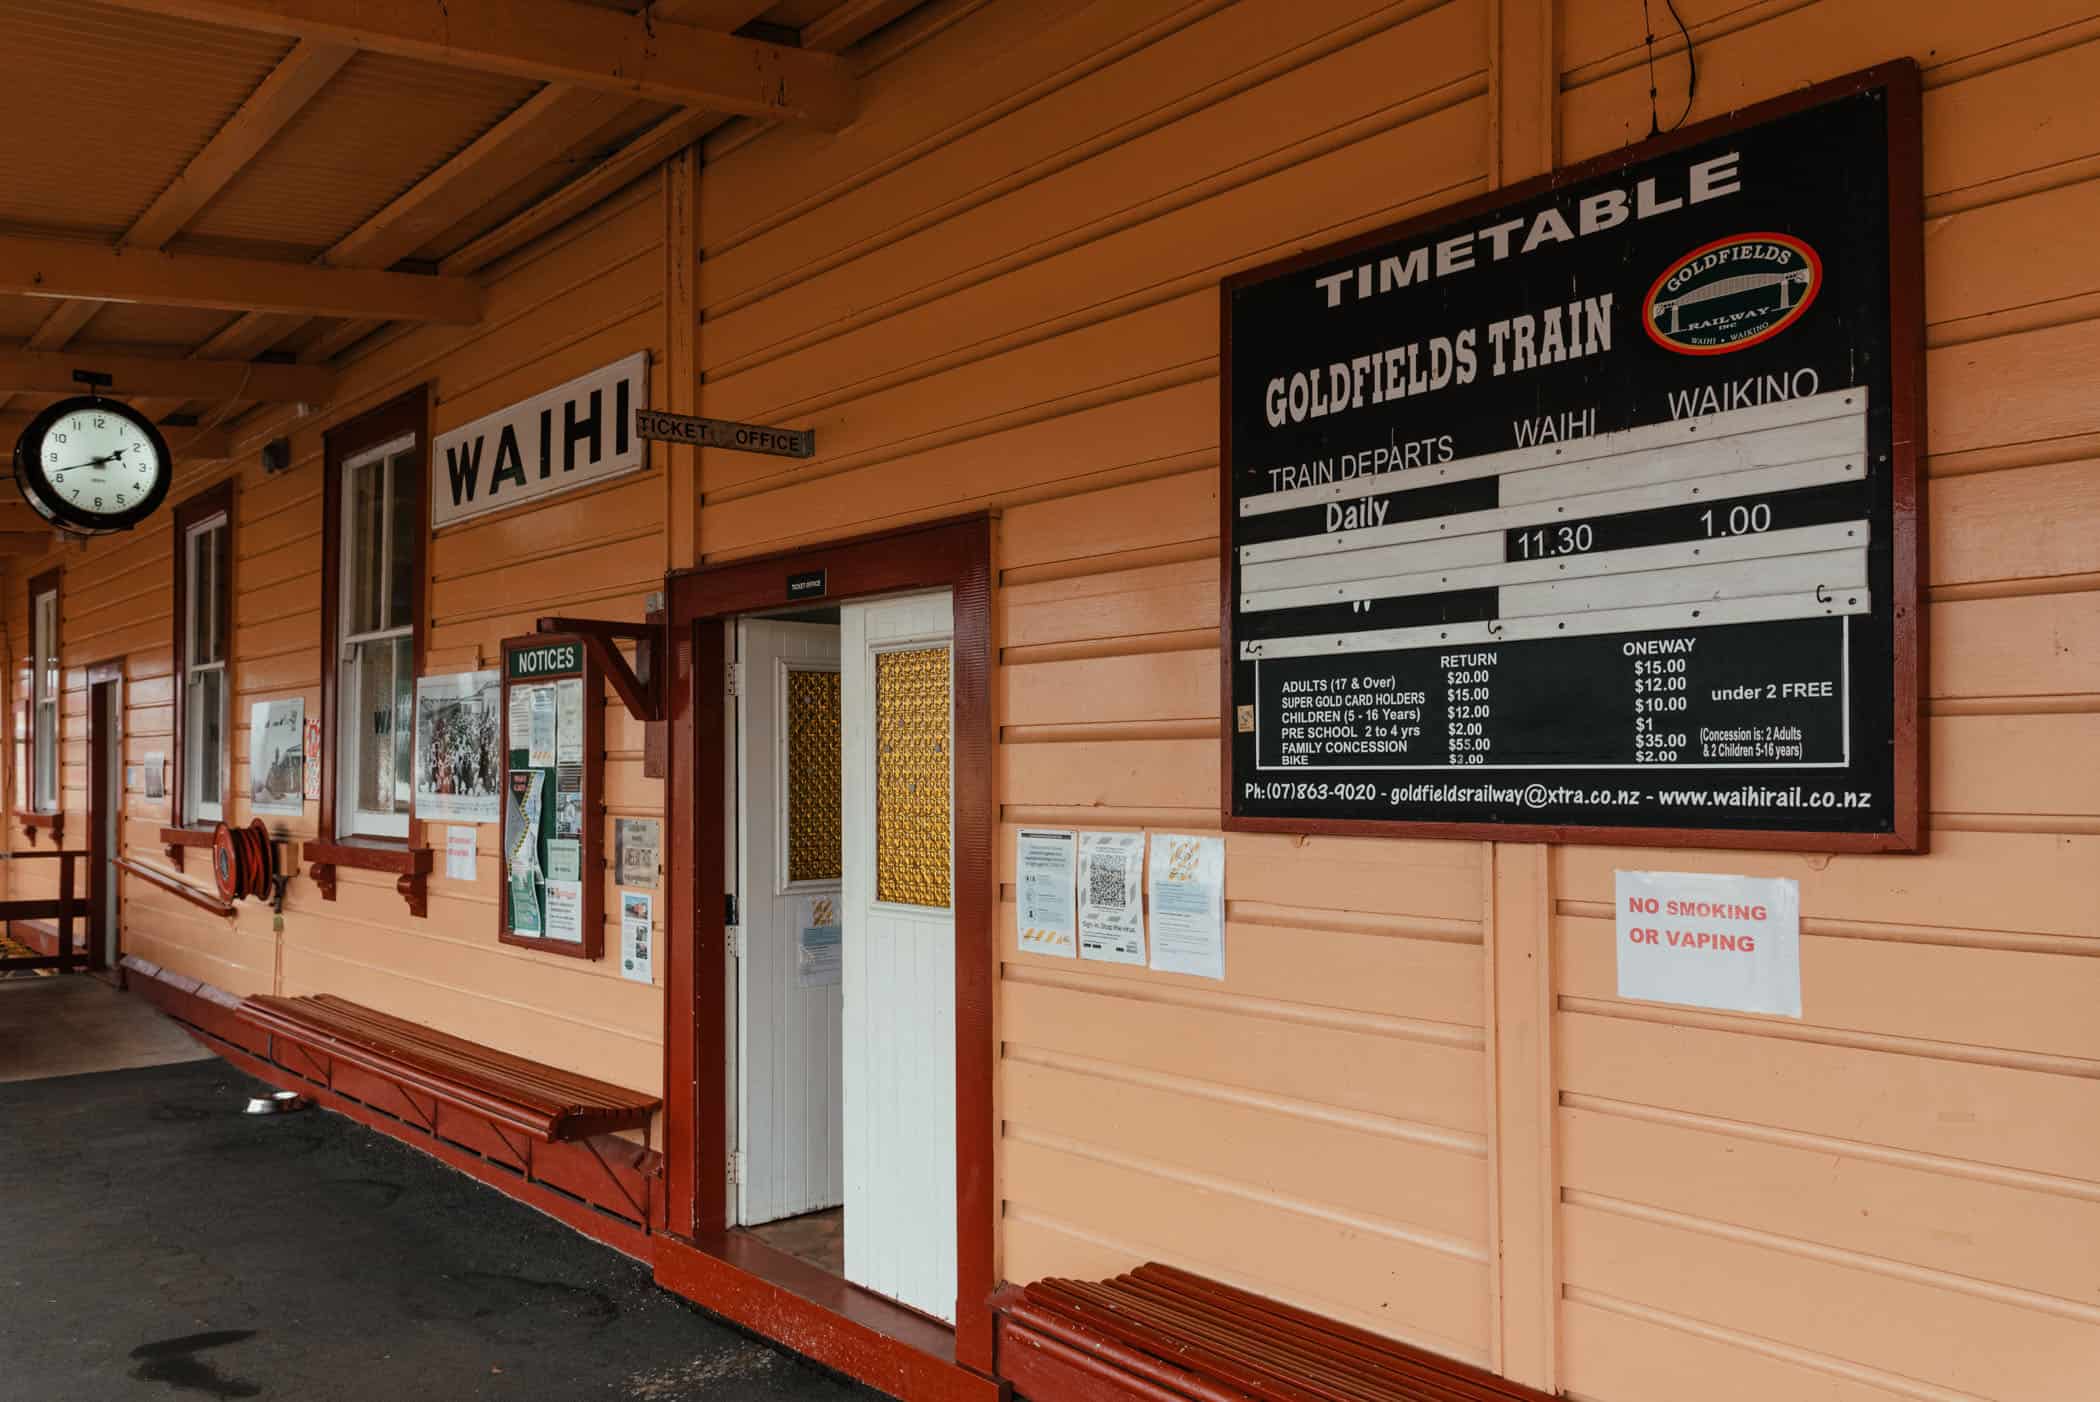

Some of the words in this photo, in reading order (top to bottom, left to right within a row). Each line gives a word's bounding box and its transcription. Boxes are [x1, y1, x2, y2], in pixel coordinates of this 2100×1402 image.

[1315, 151, 1741, 308] TIMETABLE
[1667, 245, 1791, 292] GOLDFIELDS
[1688, 307, 1770, 331] RAILWAY
[1730, 322, 1769, 340] WAIKINO
[1266, 328, 1477, 428] GOLDFIELDS
[1488, 294, 1613, 377] TRAIN
[1513, 408, 1596, 448] WAIHI
[1669, 368, 1818, 420] WAIKINO
[447, 378, 629, 506] WAIHI
[639, 416, 707, 438] TICKET
[736, 429, 799, 451] OFFICE
[1269, 459, 1332, 493] TRAIN
[1342, 435, 1453, 480] DEPARTS
[1326, 497, 1390, 532] Daily
[1517, 525, 1593, 559] 11.30
[1701, 503, 1771, 537] 1.00
[1623, 638, 1696, 656] ONEWAY
[518, 646, 575, 673] NOTICES
[1441, 652, 1497, 668] RETURN
[1635, 659, 1685, 676] $15.00
[1282, 679, 1327, 693] ADULTS
[1331, 679, 1347, 693] (17
[1351, 678, 1360, 689] &
[1363, 676, 1395, 690] Over)
[1448, 670, 1489, 685] $20.00
[1635, 677, 1686, 694] $12.00
[1448, 688, 1489, 702] $15.00
[1711, 685, 1762, 701] under
[1766, 684, 1777, 699] 2
[1782, 682, 1833, 698] FREE
[1282, 696, 1313, 709] SUPER
[1315, 695, 1342, 708] GOLD
[1345, 694, 1373, 706] CARD
[1376, 692, 1425, 705] HOLDERS
[1635, 697, 1687, 713] $10.00
[1282, 710, 1340, 724] CHILDREN
[1344, 710, 1354, 723] (5
[1365, 709, 1378, 720] 16
[1382, 707, 1421, 722] Years)
[1448, 705, 1489, 719] $12.00
[1281, 727, 1304, 739] PRE
[1307, 726, 1357, 738] SCHOOL
[1365, 725, 1372, 737] 2
[1376, 725, 1387, 737] to
[1390, 725, 1397, 736] 4
[1401, 726, 1421, 739] yrs
[1448, 723, 1482, 736] $2.00
[1636, 717, 1653, 732] $1
[1635, 734, 1686, 749] $35.00
[1700, 728, 1751, 744] (Concession
[1754, 728, 1764, 741] is:
[1766, 728, 1772, 740] 2
[1773, 727, 1801, 740] Adults
[1282, 742, 1322, 754] FAMILY
[1325, 740, 1407, 753] CONCESSION
[1449, 738, 1490, 751] $55.00
[1703, 744, 1709, 757] &
[1711, 744, 1717, 757] 2
[1719, 743, 1754, 757] Children
[1755, 743, 1773, 756] 5-16
[1775, 743, 1802, 760] years)
[1282, 755, 1308, 765] BIKE
[1636, 750, 1677, 763] $2.00
[1391, 783, 1640, 809] goldfieldsrailway@xtra.co.nz
[1658, 785, 1871, 808] www.waihirail.co.nz
[1629, 896, 1659, 914] NO
[1666, 900, 1767, 921] SMOKING
[1629, 927, 1659, 945] OR
[1665, 930, 1755, 953] VAPING
